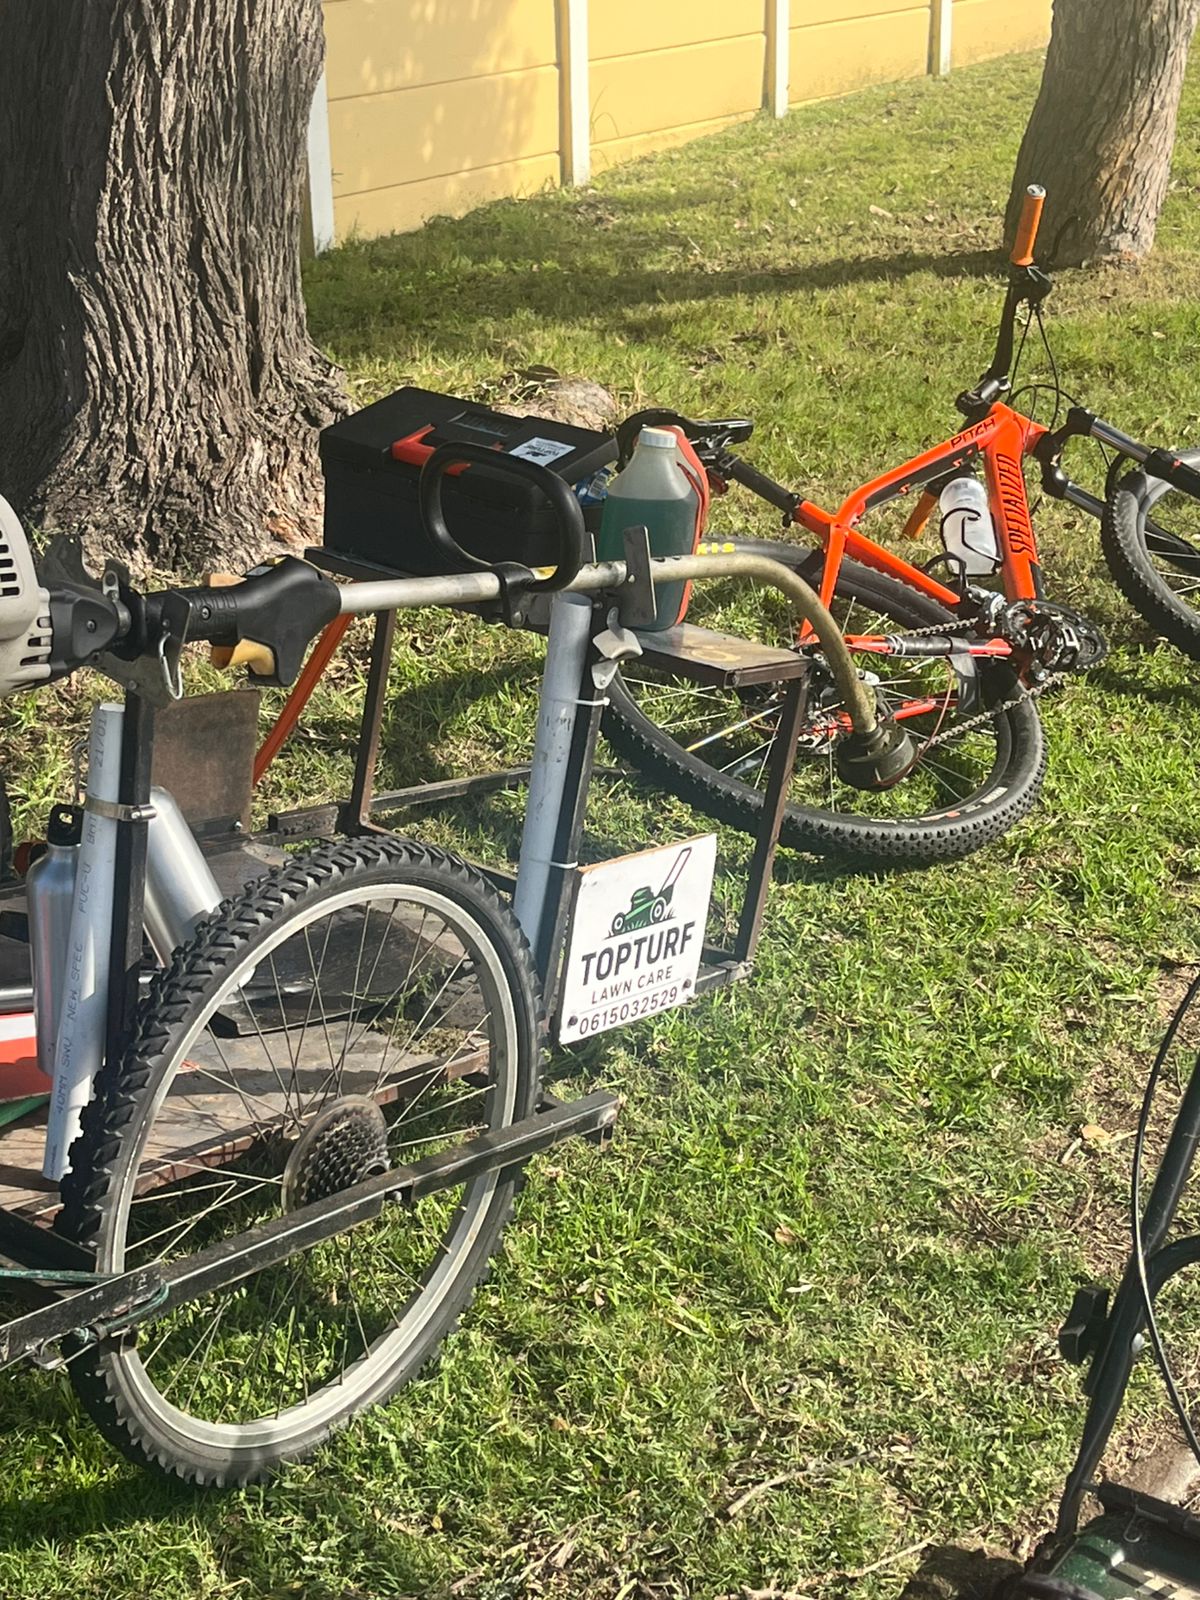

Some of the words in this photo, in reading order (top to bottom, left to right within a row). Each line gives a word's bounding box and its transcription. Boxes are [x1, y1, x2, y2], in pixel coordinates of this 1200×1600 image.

[950, 418, 996, 449] PITCH
[996, 453, 1033, 555] SPECIALIZED
[71, 941, 83, 982] SPEC
[581, 920, 696, 986] TOPTURF
[67, 988, 78, 1021] NEW
[591, 978, 632, 1005] LAWN
[637, 965, 674, 989] CARE
[579, 986, 678, 1036] 0615032529
